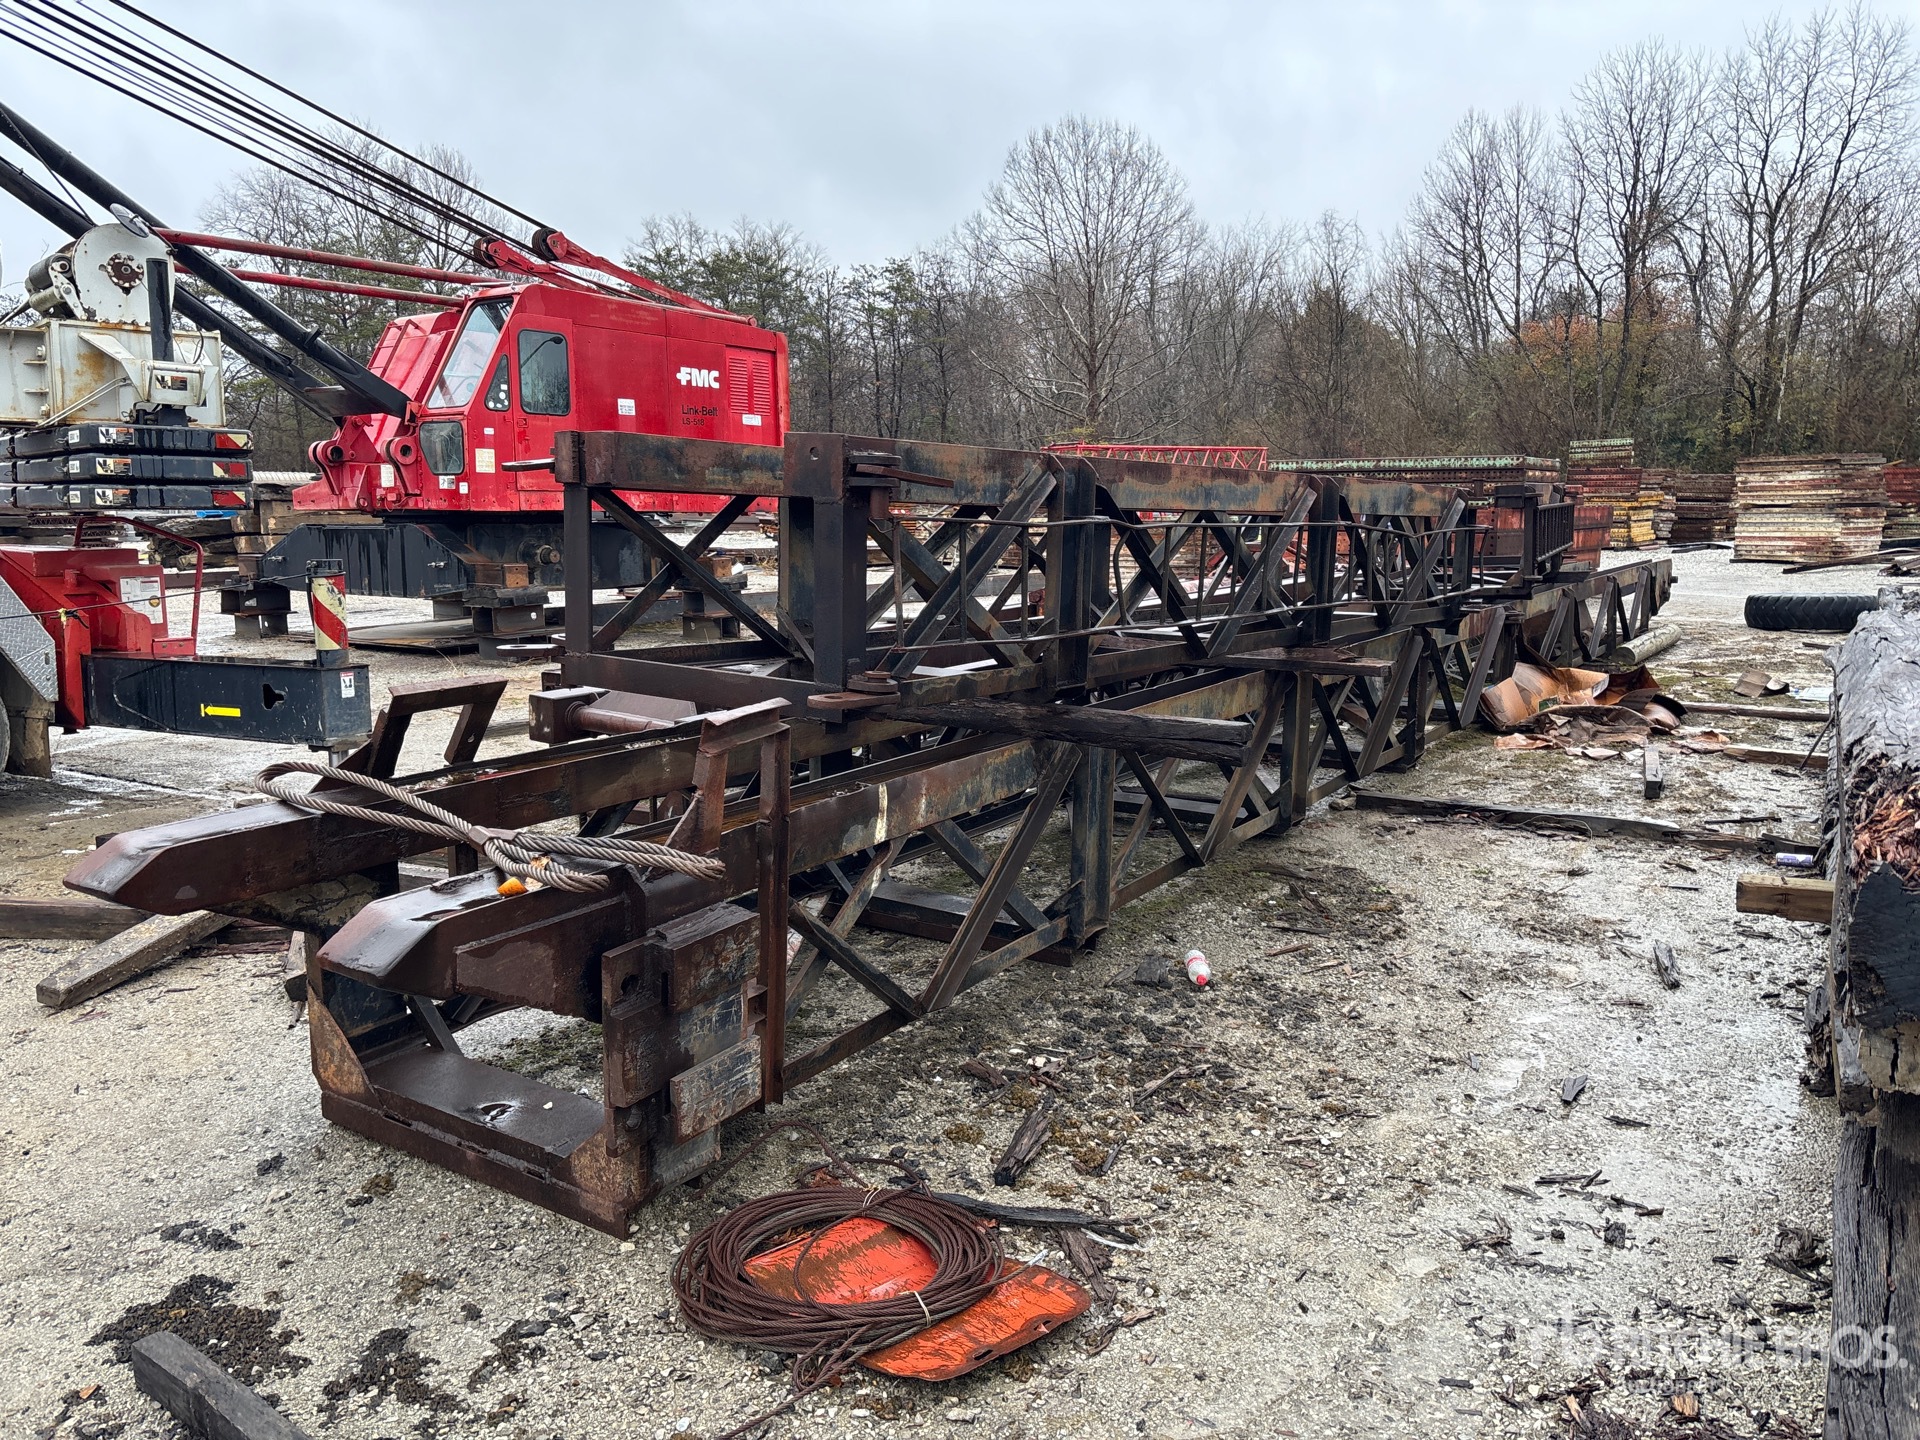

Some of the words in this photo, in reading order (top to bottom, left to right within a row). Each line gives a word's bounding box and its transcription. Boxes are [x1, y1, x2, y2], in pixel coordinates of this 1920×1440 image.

[676, 366, 720, 389] FMC
[681, 404, 719, 417] Link-Belt
[682, 417, 705, 427] LS-518
